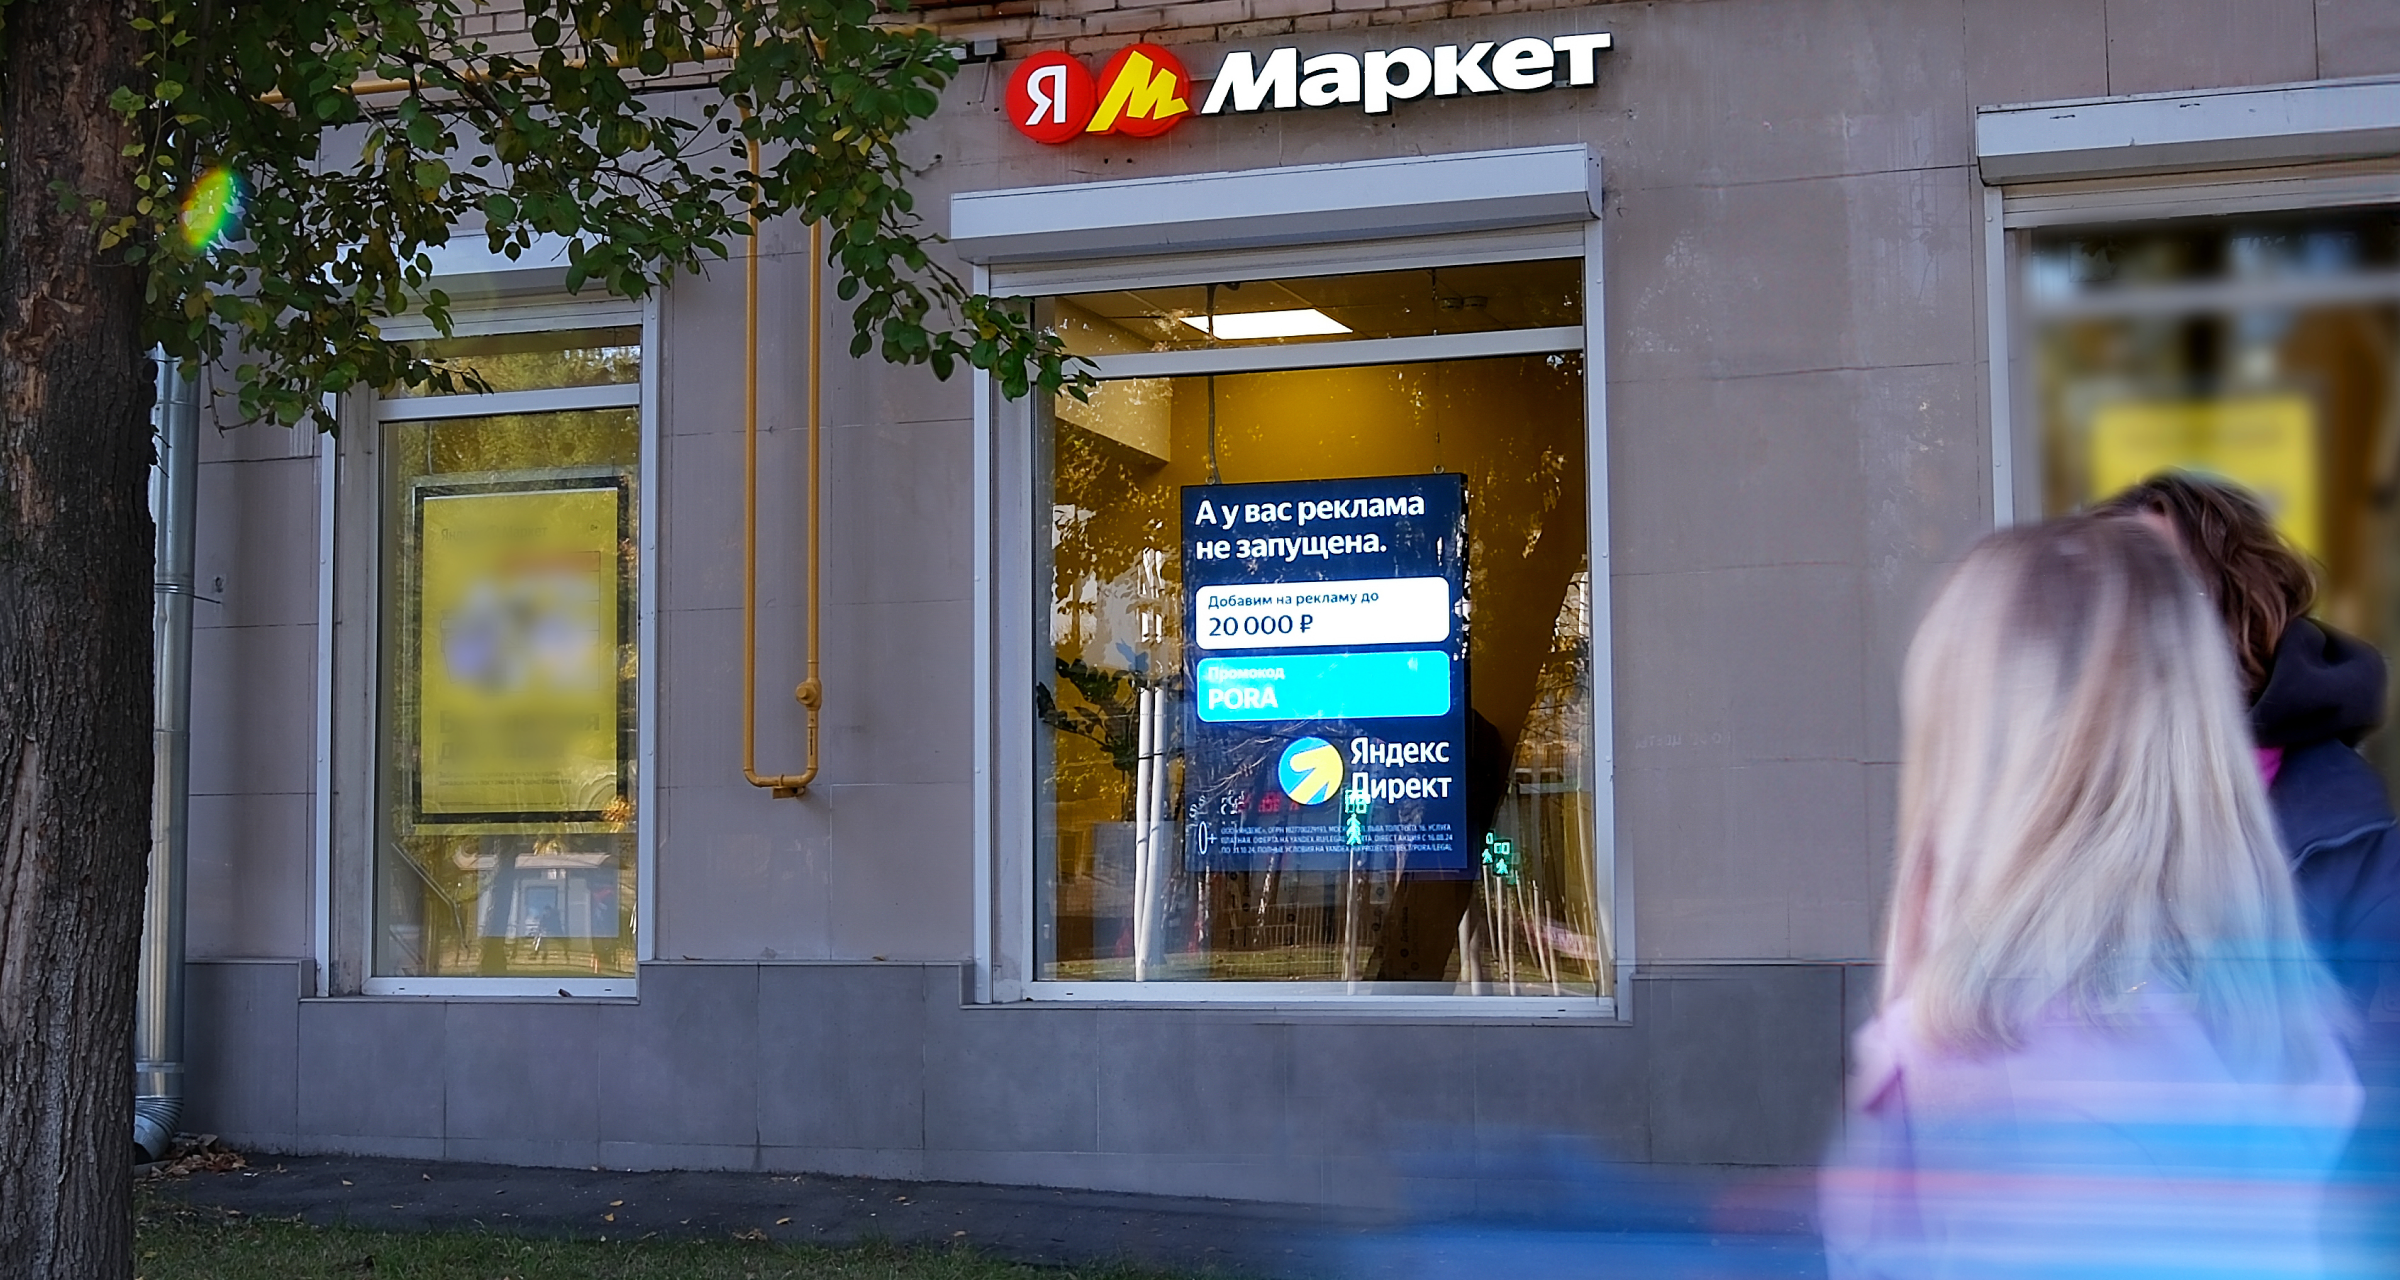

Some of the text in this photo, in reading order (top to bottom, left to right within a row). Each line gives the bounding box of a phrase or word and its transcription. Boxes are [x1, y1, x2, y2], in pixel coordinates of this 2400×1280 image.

[1025, 64, 1067, 126] Я
[1200, 32, 1613, 115] Маркет
[1195, 495, 1425, 530] А у вас реклама
[1196, 533, 1387, 562] не запущена.
[1208, 591, 1379, 609] Добавим на рекламу до
[1208, 666, 1285, 681] Промокод
[1208, 686, 1278, 710] PORA
[1350, 737, 1450, 768] Яндекс
[1351, 771, 1452, 804] Директ
[1198, 820, 1218, 855] 0+
